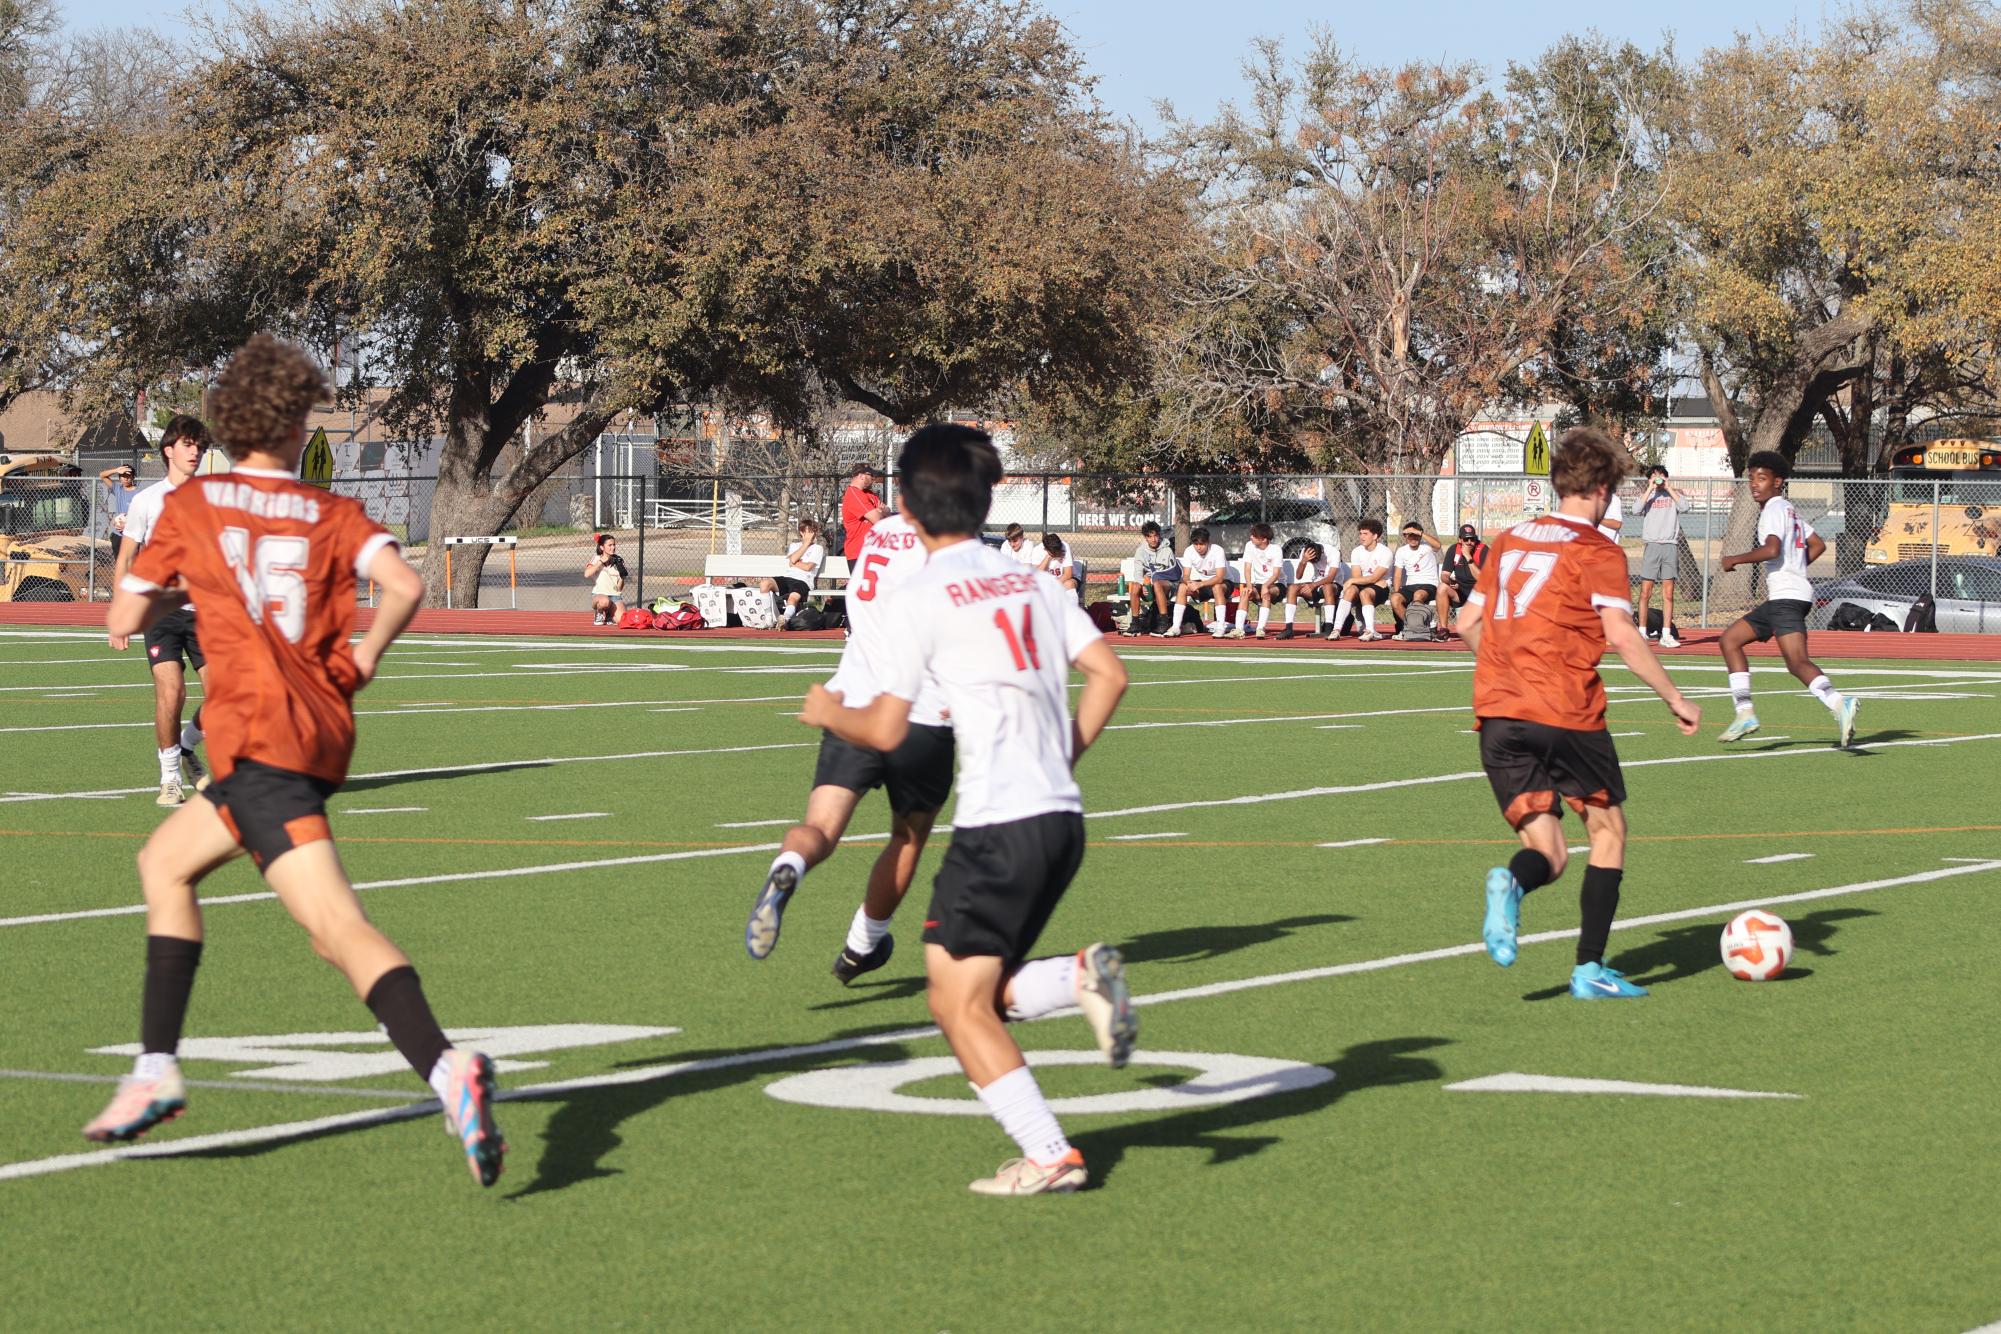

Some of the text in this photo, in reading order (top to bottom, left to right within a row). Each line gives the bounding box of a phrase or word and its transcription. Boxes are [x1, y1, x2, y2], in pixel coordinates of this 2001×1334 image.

[1927, 451, 1979, 465] SCHOOL BUS
[202, 481, 320, 524] WARRIORS
[1078, 513, 1105, 526] HERE
[1108, 513, 1126, 527] WE
[219, 526, 310, 644] 15
[856, 554, 890, 602] 5
[1494, 549, 1558, 619] 17
